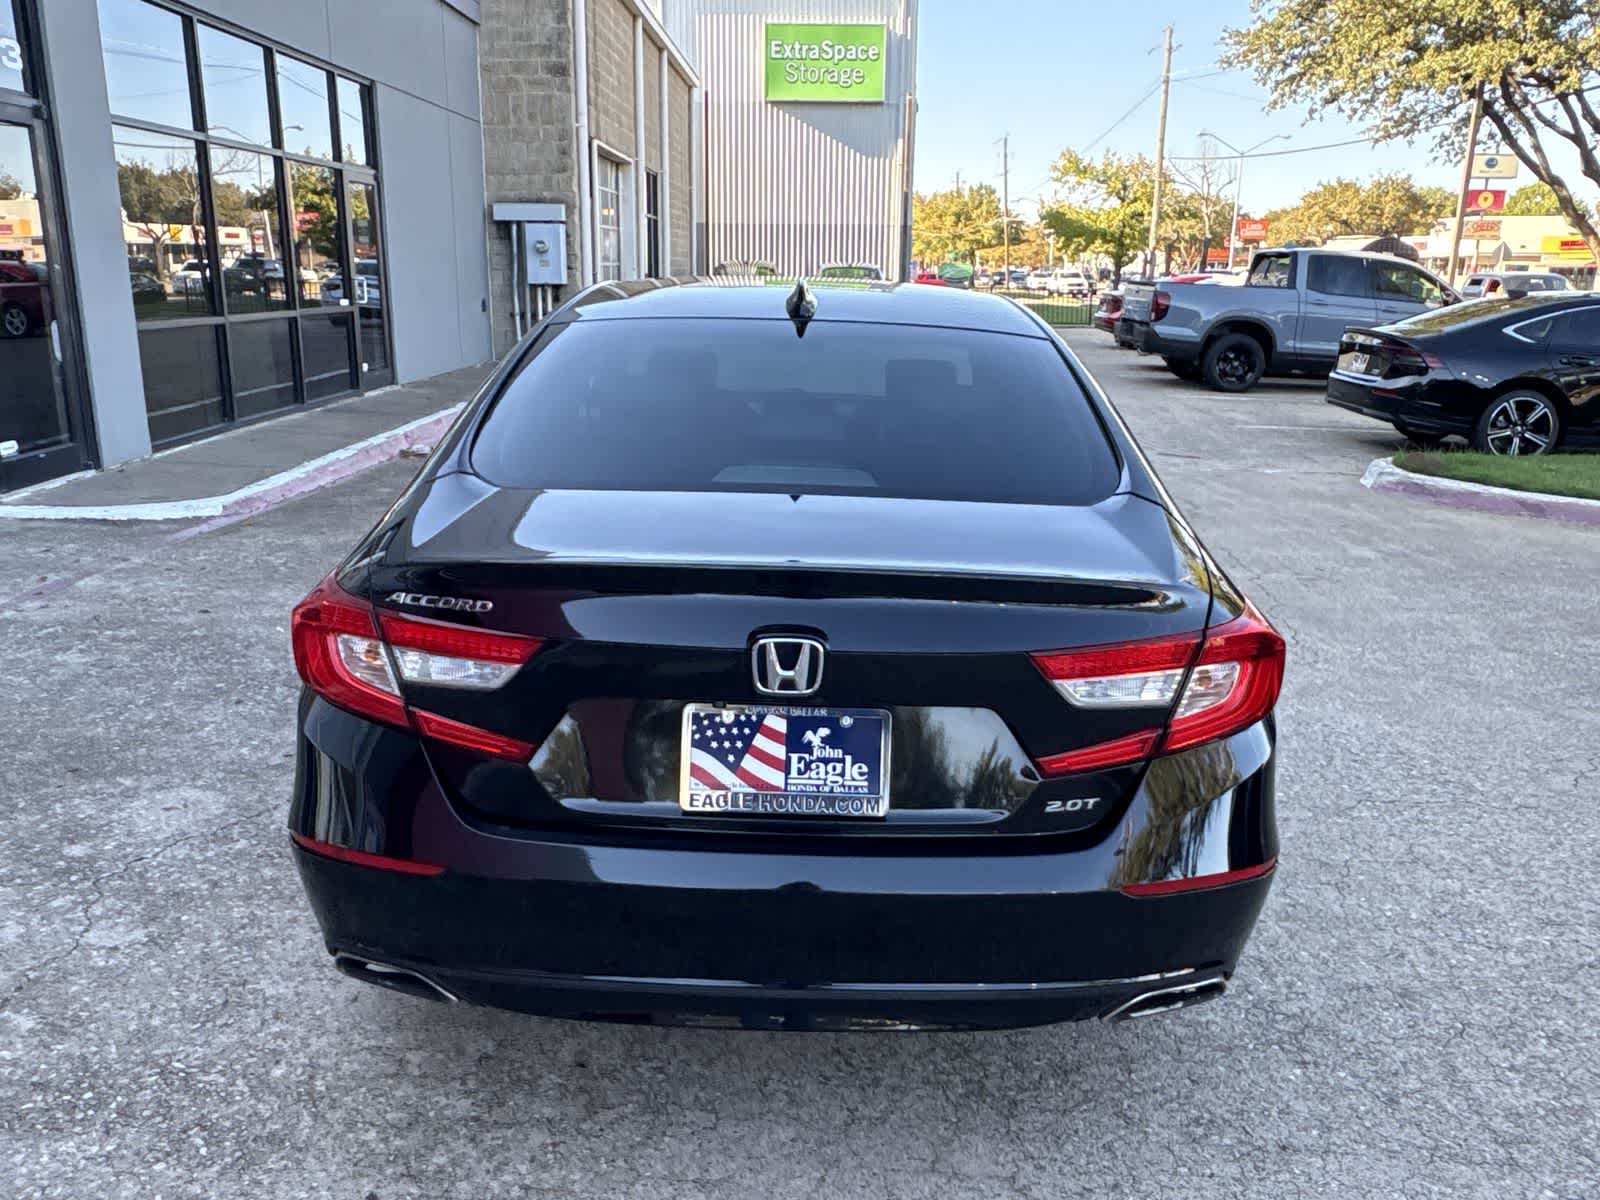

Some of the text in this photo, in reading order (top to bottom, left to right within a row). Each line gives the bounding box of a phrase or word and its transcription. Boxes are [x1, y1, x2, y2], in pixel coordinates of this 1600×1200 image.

[785, 62, 865, 87] Storage
[385, 591, 494, 612] ACCORD
[809, 745, 843, 760] John
[788, 753, 869, 786] Eagle
